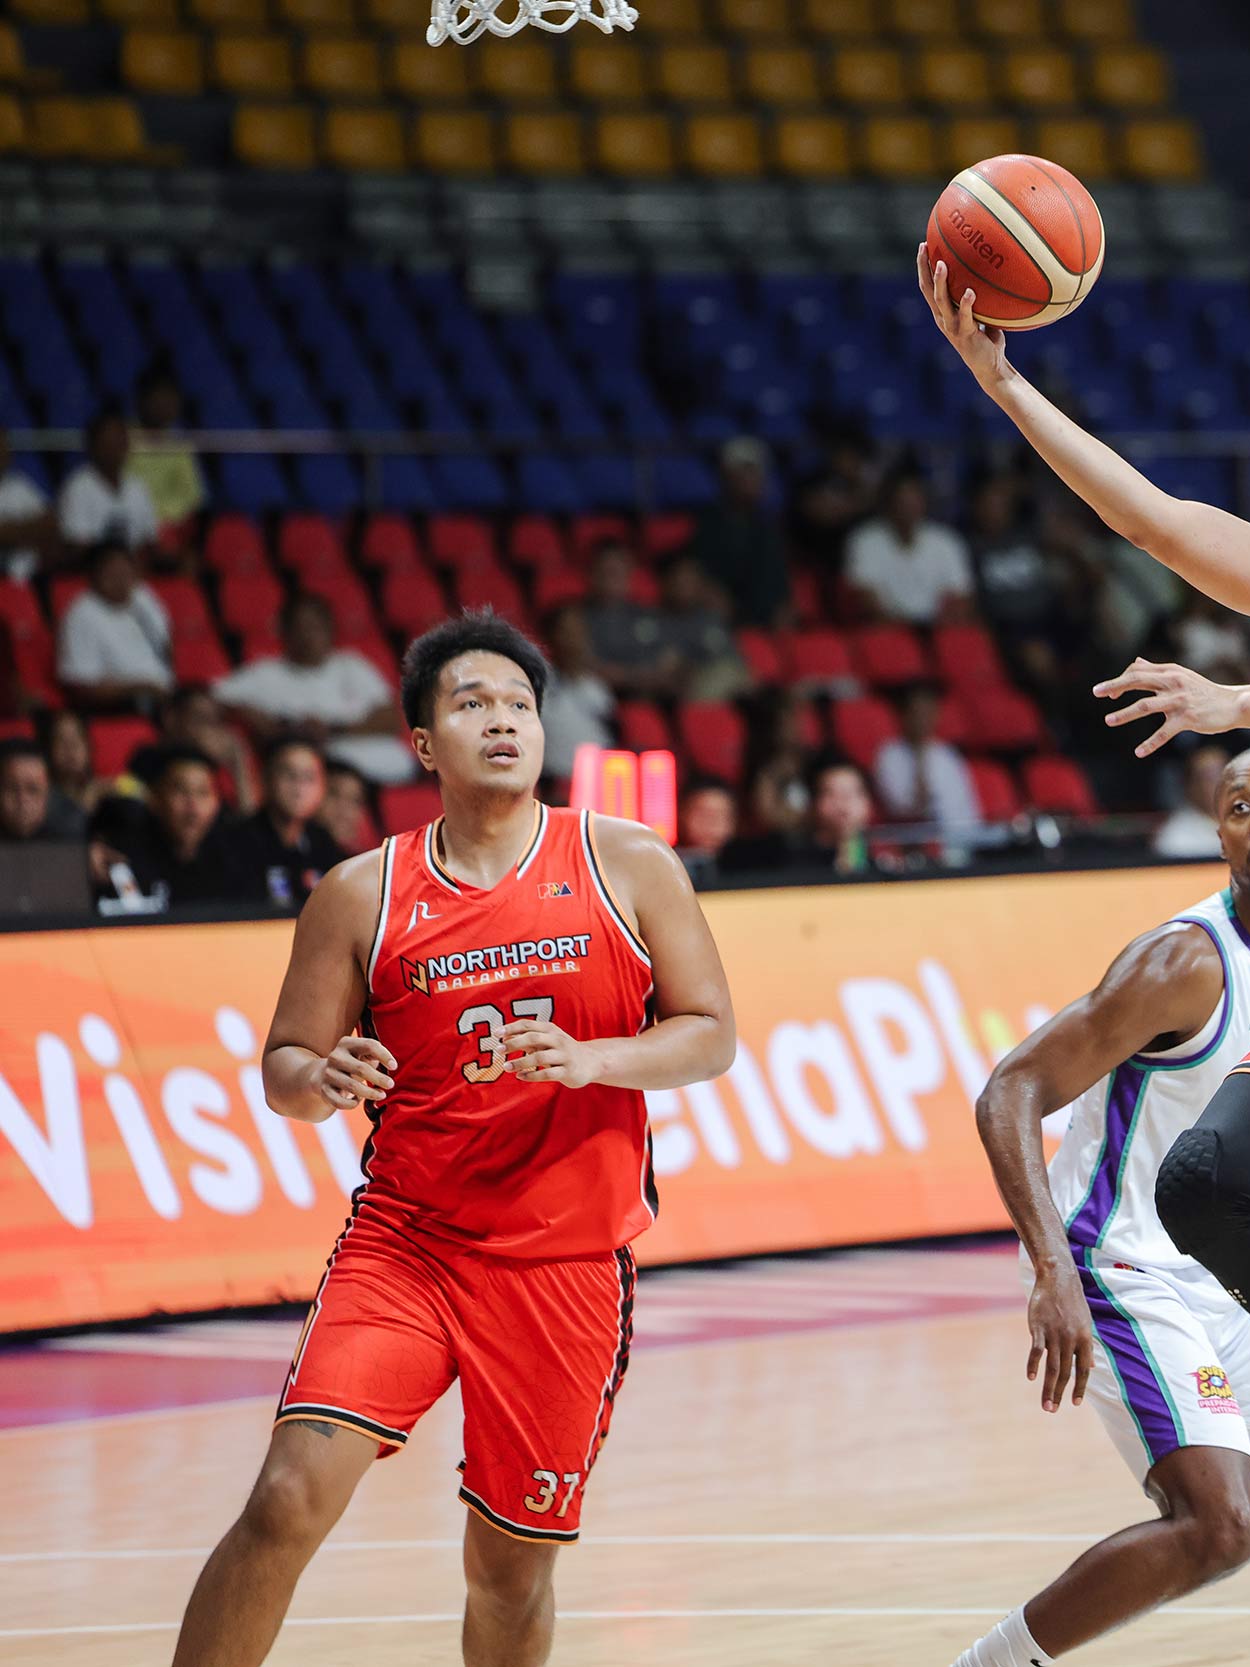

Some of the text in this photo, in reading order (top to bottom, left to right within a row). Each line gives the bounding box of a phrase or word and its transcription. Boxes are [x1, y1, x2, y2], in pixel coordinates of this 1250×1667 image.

[948, 209, 1005, 270] molten
[537, 882, 573, 899] PBA
[427, 933, 592, 980] NORTHPORT
[437, 960, 577, 992] BATANG PIER
[523, 1469, 581, 1518] 37
